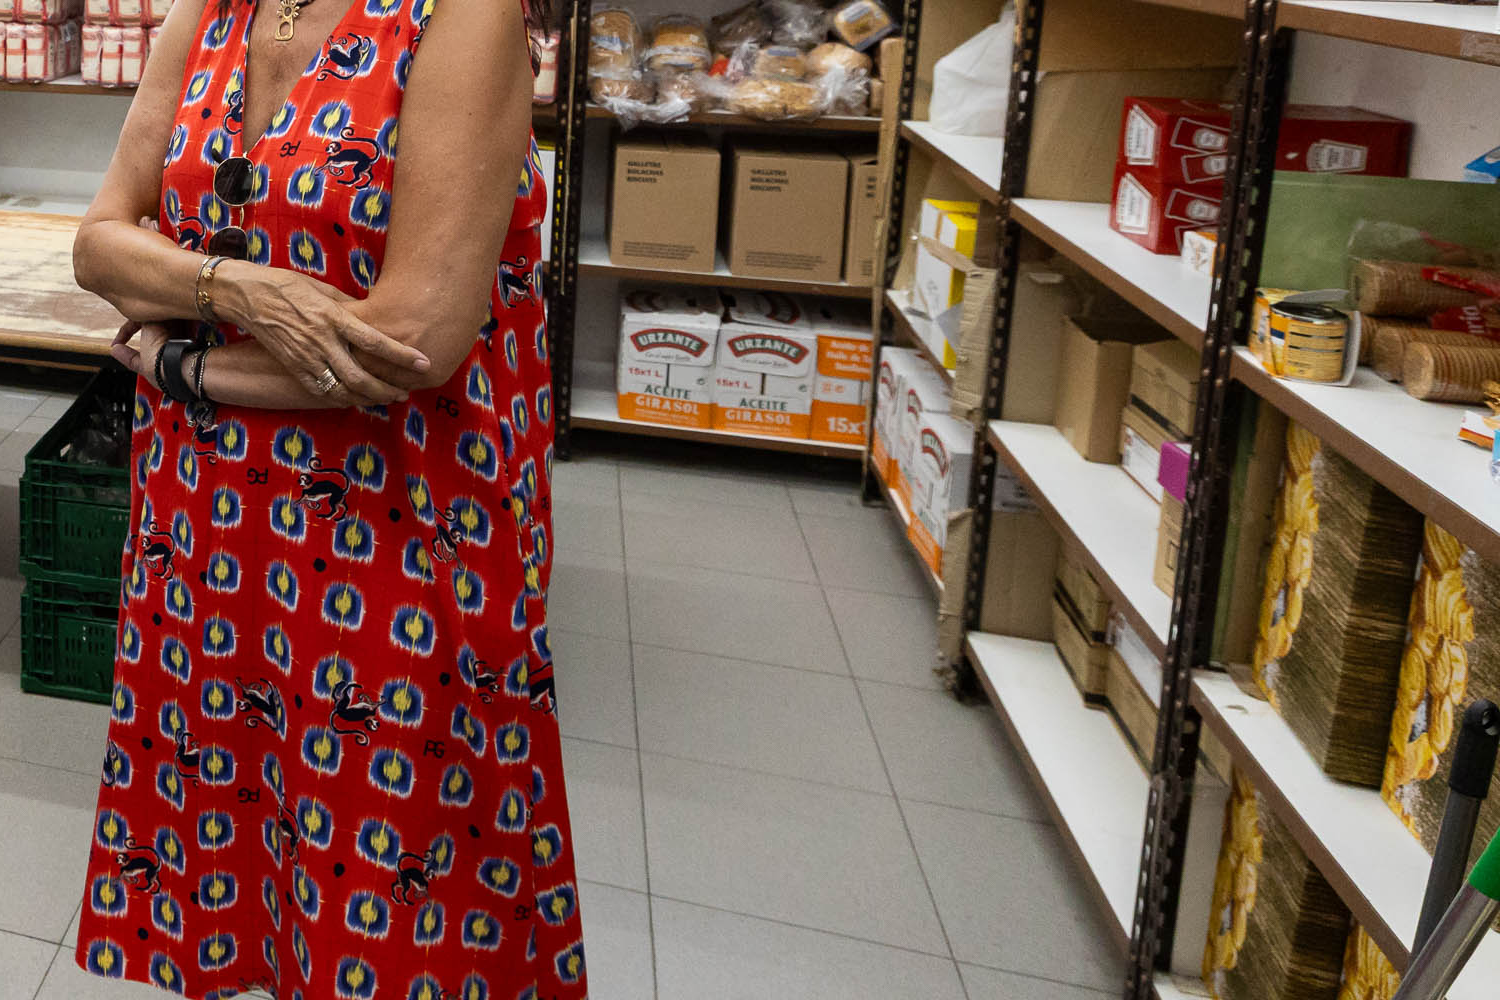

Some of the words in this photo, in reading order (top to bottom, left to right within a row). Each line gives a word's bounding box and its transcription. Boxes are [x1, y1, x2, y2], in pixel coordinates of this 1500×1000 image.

[637, 331, 702, 351] URZANTE
[734, 338, 799, 357] URZANTE
[644, 383, 692, 401] ACEITE
[635, 395, 700, 416] GIRASOL
[739, 397, 789, 412] ACEITE
[725, 406, 793, 426] GIRASOL
